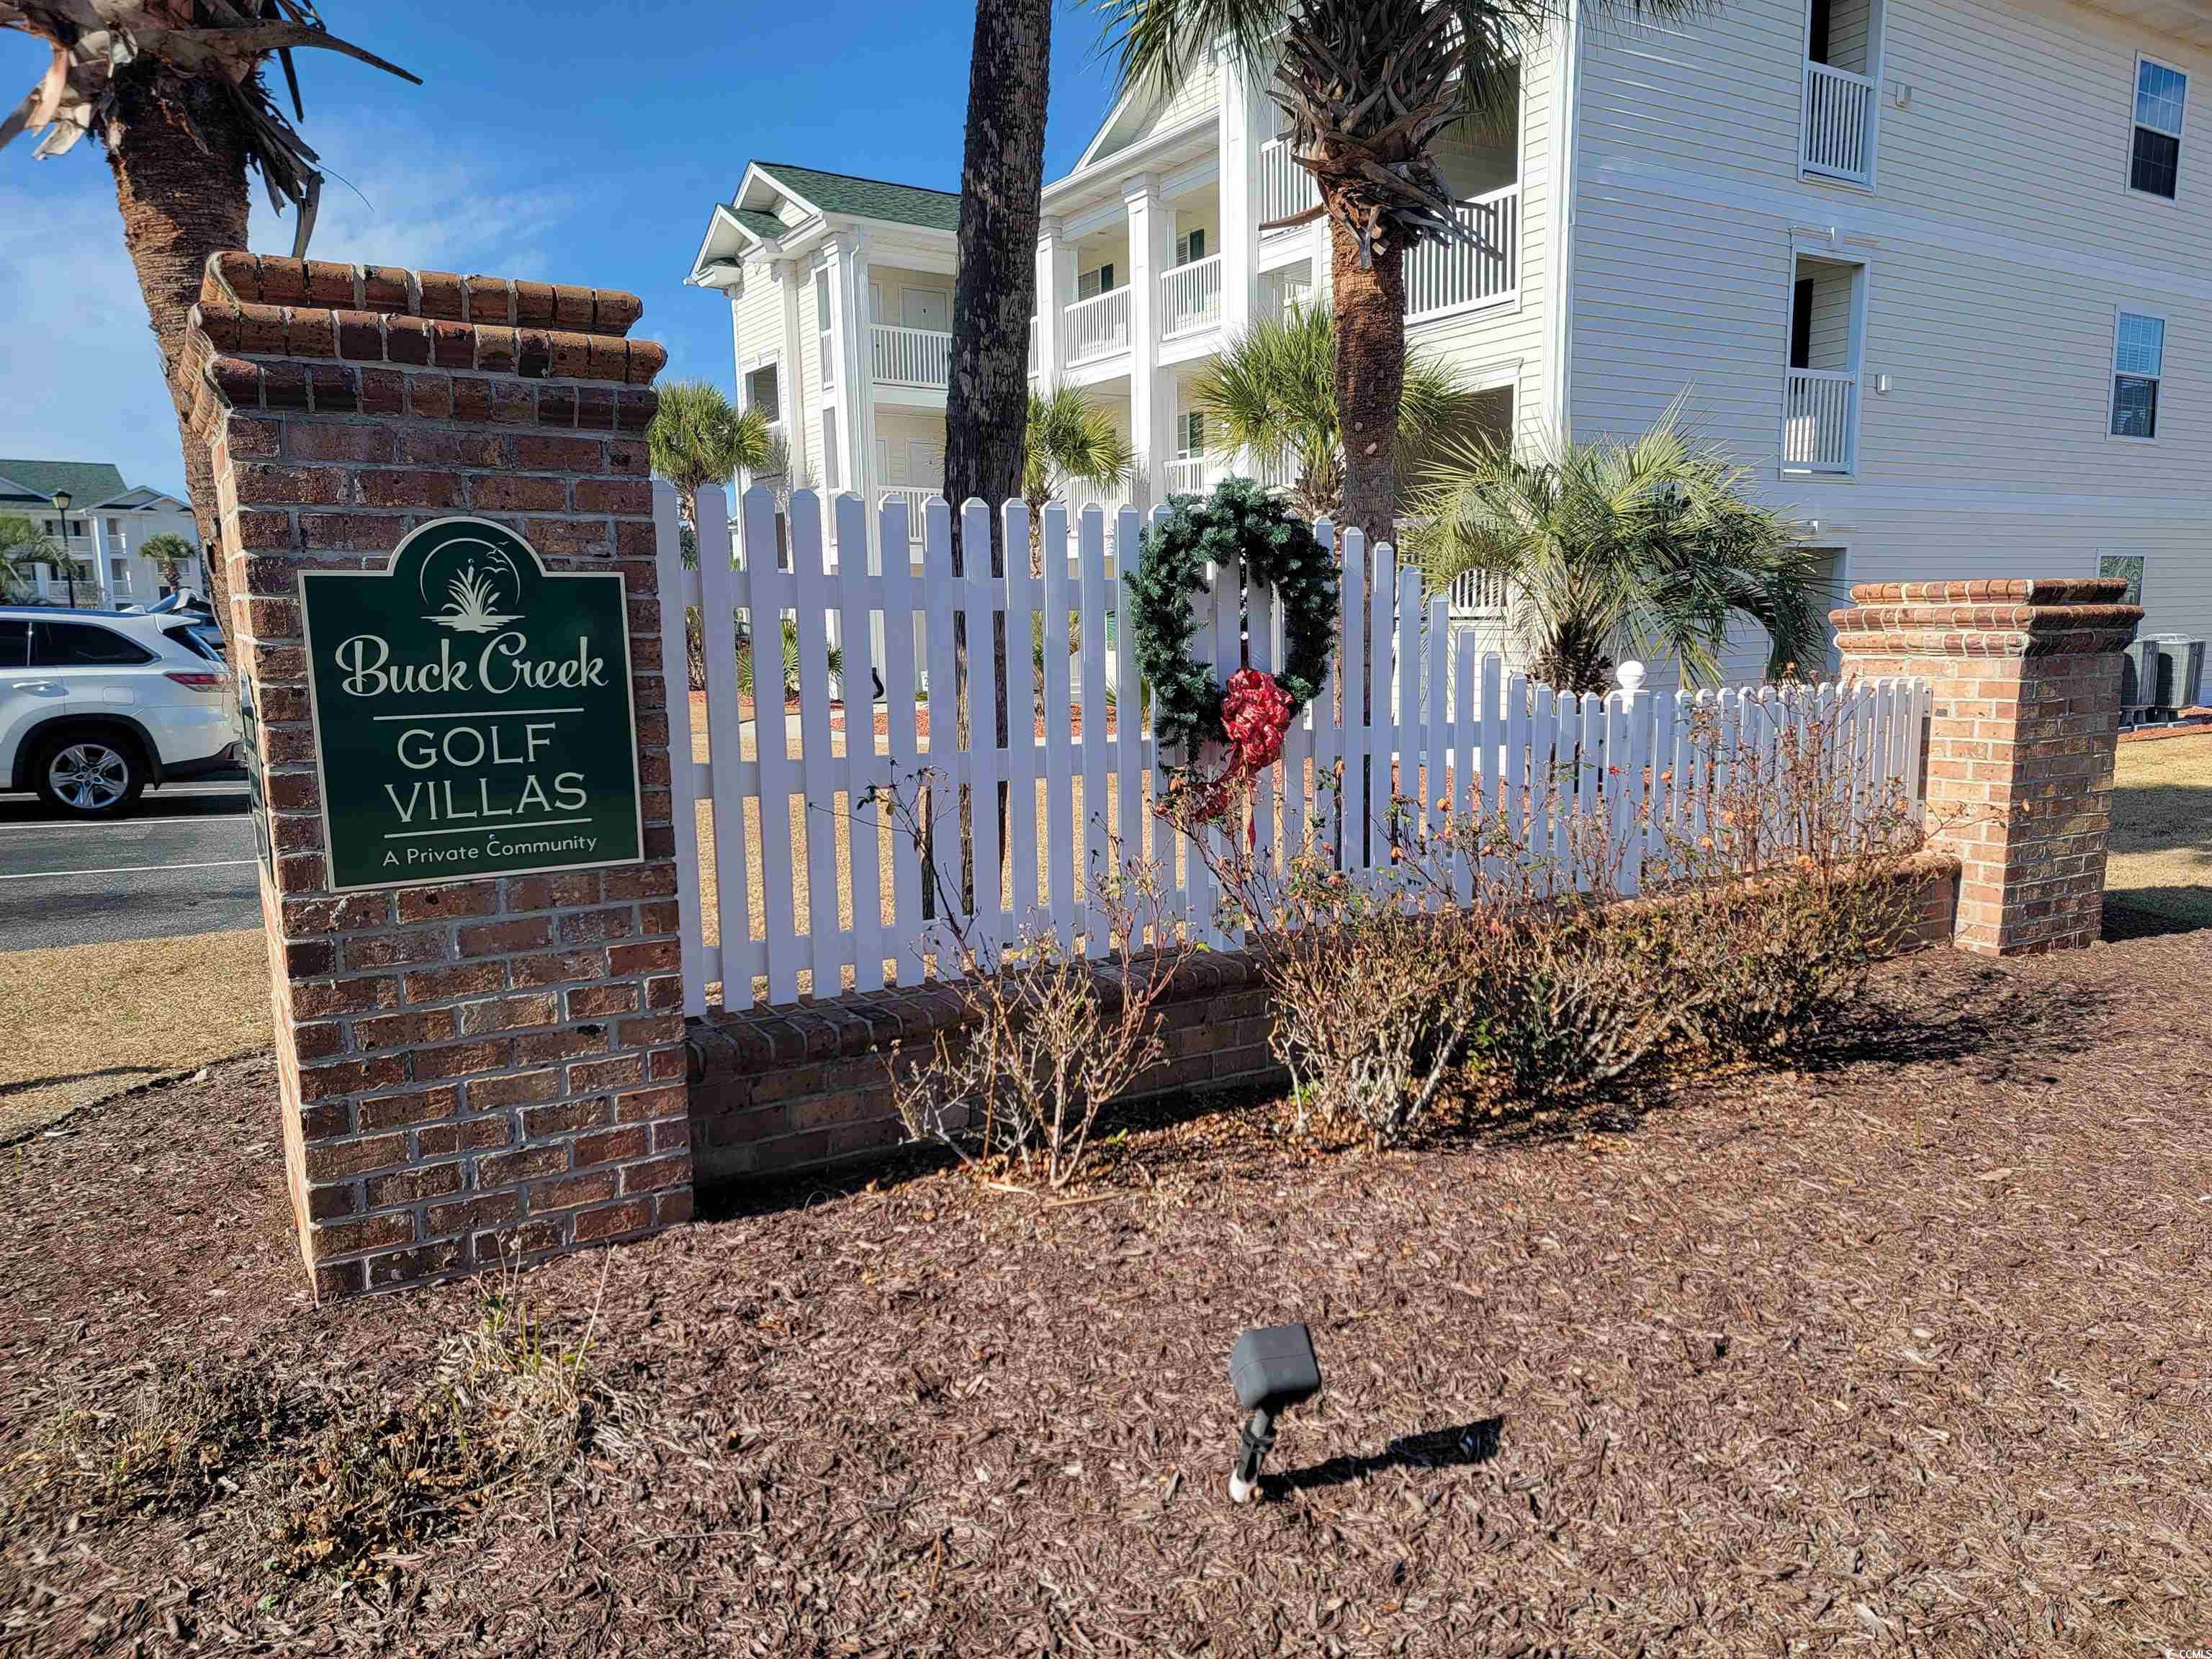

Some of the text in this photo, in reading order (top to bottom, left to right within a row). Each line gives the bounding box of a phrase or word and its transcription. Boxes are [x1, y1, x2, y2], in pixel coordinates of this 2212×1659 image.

[335, 631, 609, 696] Buck Creek
[397, 721, 557, 769] GOLF
[384, 772, 588, 823] VILLAS
[382, 835, 598, 867] A Private Community
